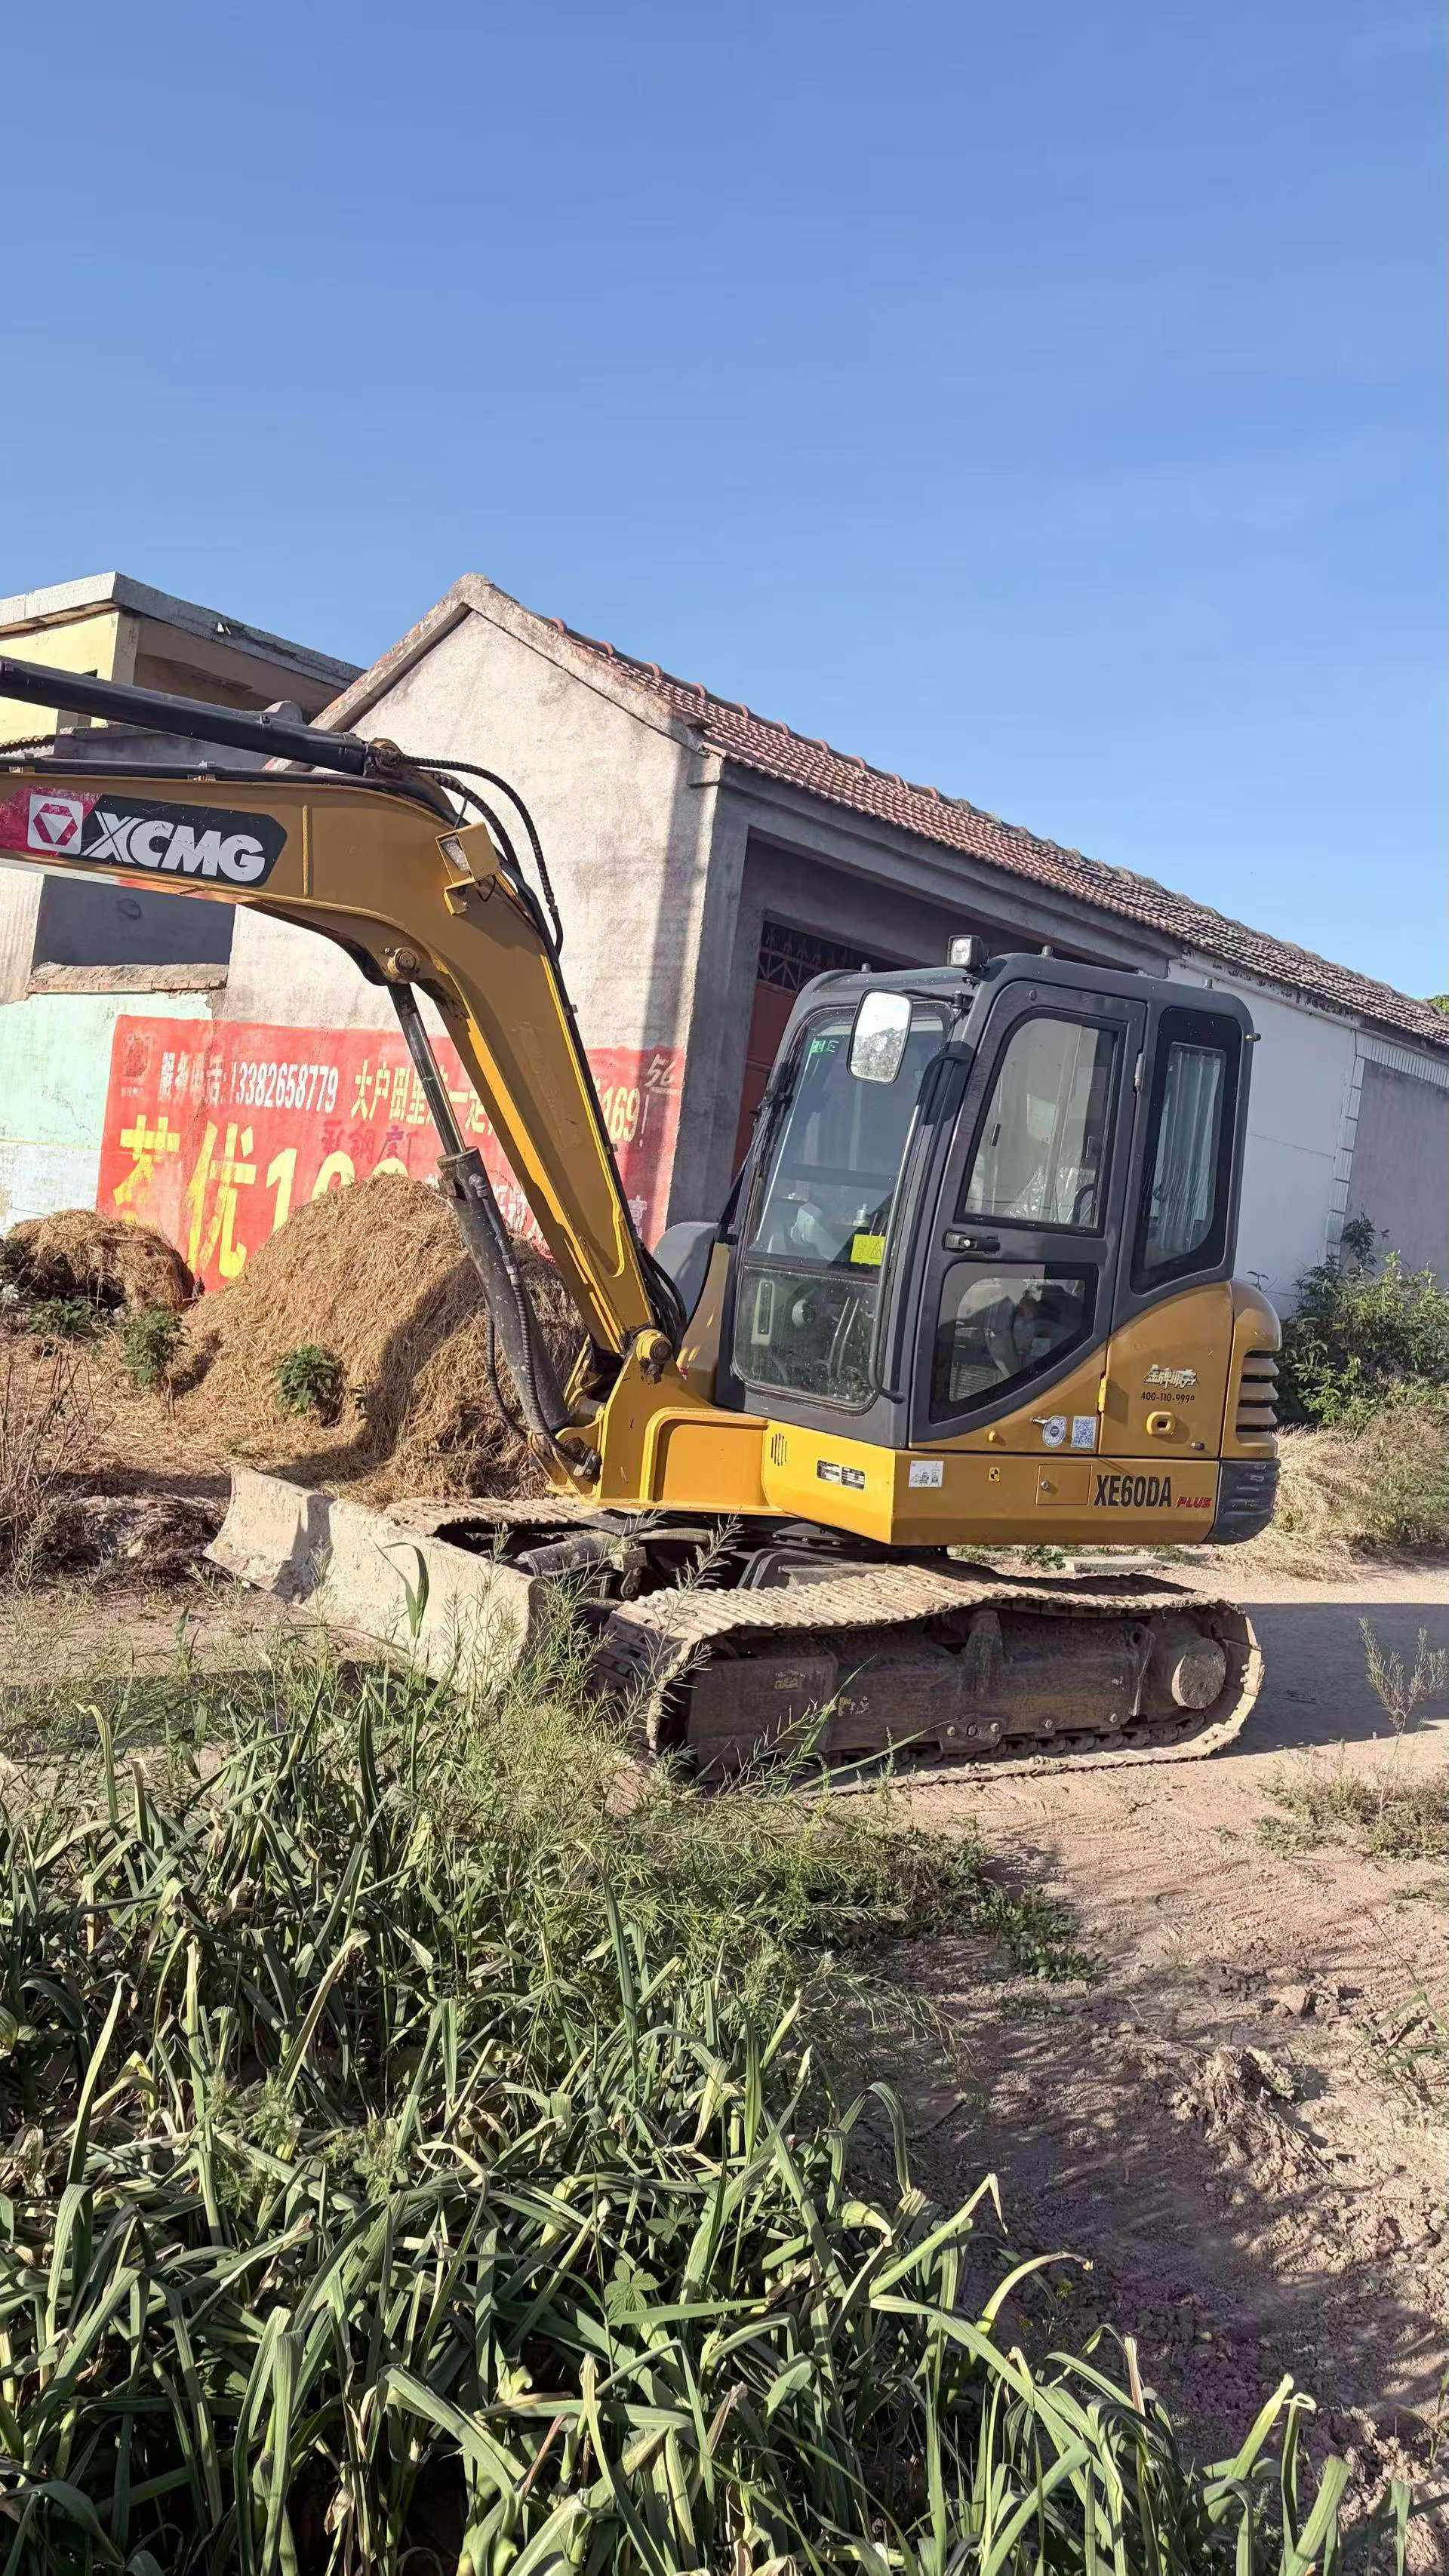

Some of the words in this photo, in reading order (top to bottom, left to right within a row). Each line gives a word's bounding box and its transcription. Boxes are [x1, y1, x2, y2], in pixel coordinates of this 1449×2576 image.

[82, 811, 266, 881] XCMG
[1094, 1474, 1172, 1508] XE60DA
[1176, 1496, 1212, 1508] PLUS
